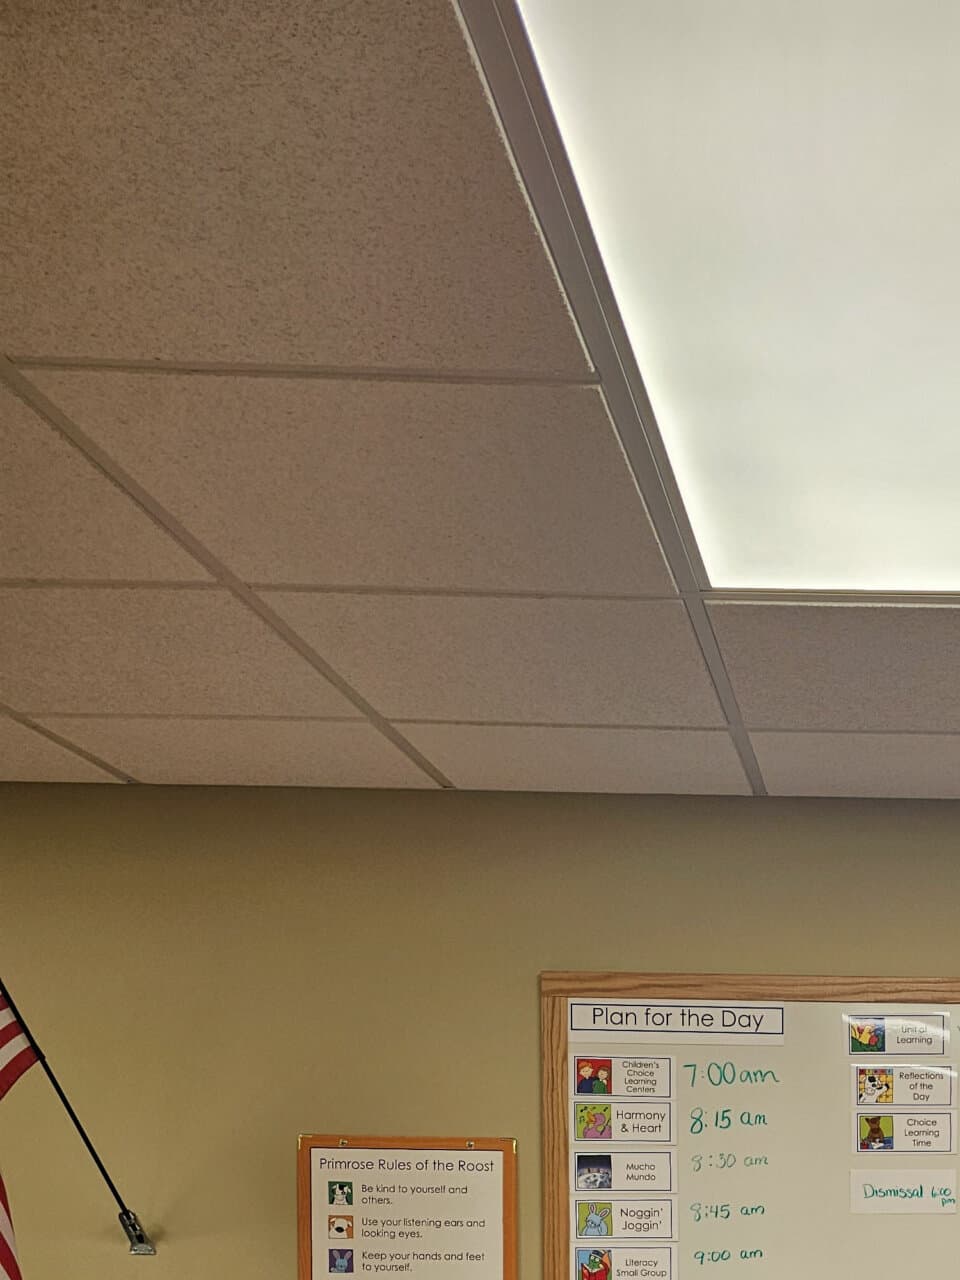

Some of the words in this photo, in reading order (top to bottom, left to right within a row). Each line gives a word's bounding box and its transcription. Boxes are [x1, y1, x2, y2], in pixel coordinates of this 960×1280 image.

[592, 1007, 638, 1026] Plan
[644, 1008, 673, 1027] for
[680, 1008, 714, 1027] the
[722, 1010, 764, 1032] Day
[896, 1036, 933, 1045] Learning
[621, 1061, 660, 1069] Children's
[626, 1069, 655, 1077] Choice
[899, 1072, 944, 1080] Reflections
[624, 1077, 657, 1086] Learning
[909, 1082, 918, 1090] of
[626, 1085, 656, 1094] Centers
[913, 1093, 930, 1102] Day
[616, 1110, 666, 1121] Harmony
[690, 1107, 732, 1134] 8:15
[740, 1111, 768, 1126] am
[907, 1118, 937, 1127] Choice
[620, 1124, 629, 1133] &
[632, 1123, 662, 1133] Heart
[904, 1128, 940, 1138] Learning
[912, 1139, 932, 1147] Time
[319, 1158, 374, 1170] Primrose
[378, 1159, 411, 1171] Rules
[415, 1159, 429, 1171] of
[432, 1160, 454, 1171] the
[458, 1160, 494, 1172] Roost
[626, 1162, 656, 1171] Mucho
[692, 1153, 736, 1172] 8:30
[744, 1154, 769, 1166] am
[626, 1173, 656, 1181] Mundo
[361, 1185, 374, 1193] Be
[376, 1184, 396, 1193] kind
[399, 1185, 408, 1193] to
[410, 1185, 446, 1195] yourself
[448, 1186, 468, 1194] and
[863, 1184, 923, 1199] Dismissal
[931, 1186, 952, 1198] 6:00
[361, 1196, 393, 1205] others.
[941, 1198, 956, 1207] pm
[620, 1207, 663, 1220] Noggin'
[689, 1203, 730, 1222] 8:45
[740, 1205, 765, 1216] am
[362, 1218, 378, 1226] Use
[381, 1220, 402, 1228] your
[403, 1218, 442, 1228] listening
[467, 1219, 486, 1228] and
[622, 1220, 662, 1231] Joggin'
[361, 1229, 396, 1240] looking
[398, 1231, 423, 1240] eyes.
[362, 1251, 387, 1261] Keep
[389, 1253, 410, 1262] your
[412, 1252, 441, 1261] hands
[444, 1252, 463, 1261] and
[466, 1252, 485, 1261] feet
[693, 1249, 731, 1265] 9:00
[740, 1249, 763, 1259] am
[362, 1263, 372, 1271] to
[374, 1263, 413, 1273] yourself.
[625, 1259, 658, 1269] Literacy
[616, 1269, 639, 1277] Small
[640, 1269, 667, 1279] Group
